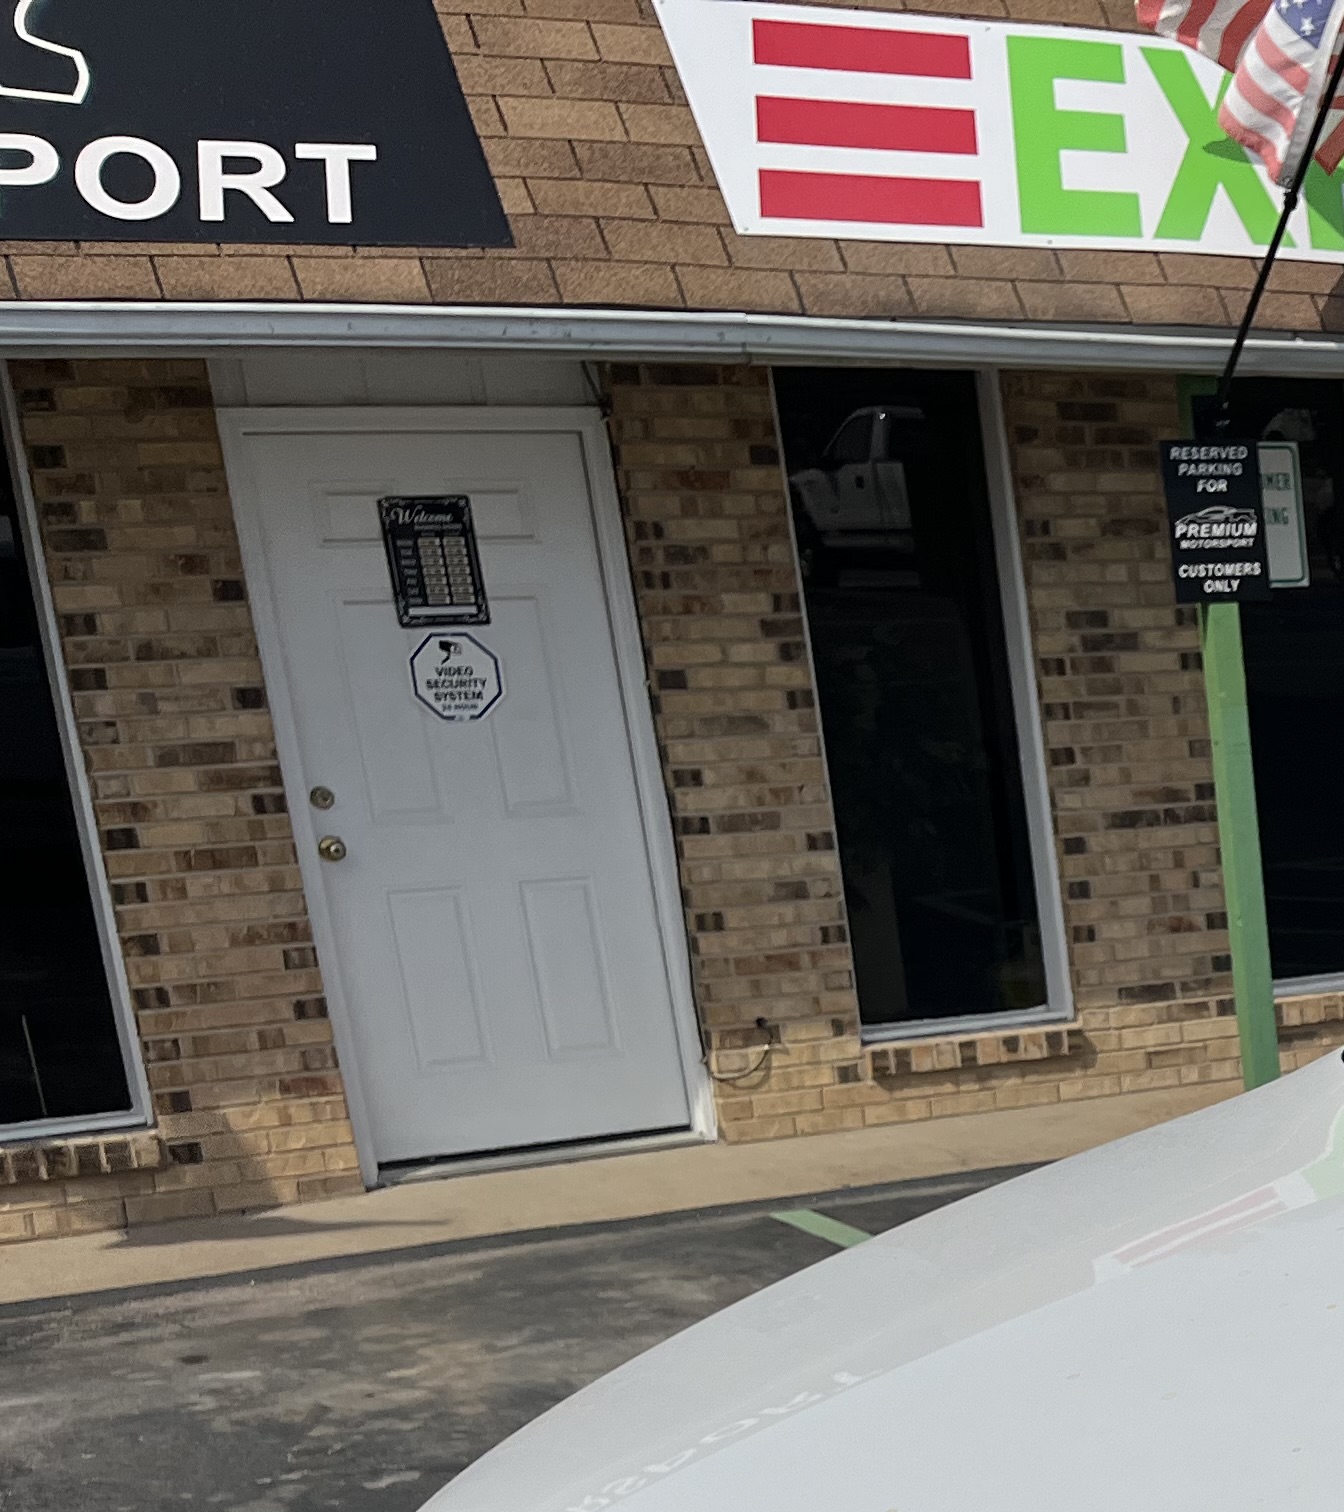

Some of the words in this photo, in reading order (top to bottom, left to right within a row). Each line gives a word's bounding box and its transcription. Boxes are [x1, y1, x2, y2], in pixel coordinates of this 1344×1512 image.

[1169, 446, 1248, 460] RESERVED
[1178, 462, 1243, 476] PARKING
[1196, 479, 1228, 492] FOR
[391, 504, 454, 525] Welcome
[1175, 522, 1258, 538] PREMIUM
[1179, 538, 1255, 549] MOTORSPORT
[1178, 562, 1261, 578] CUSTOMERS
[1203, 579, 1240, 594] ONLY
[435, 666, 473, 677] VIDEO
[426, 678, 487, 690] SECURITY
[434, 690, 484, 702] SYSTEM
